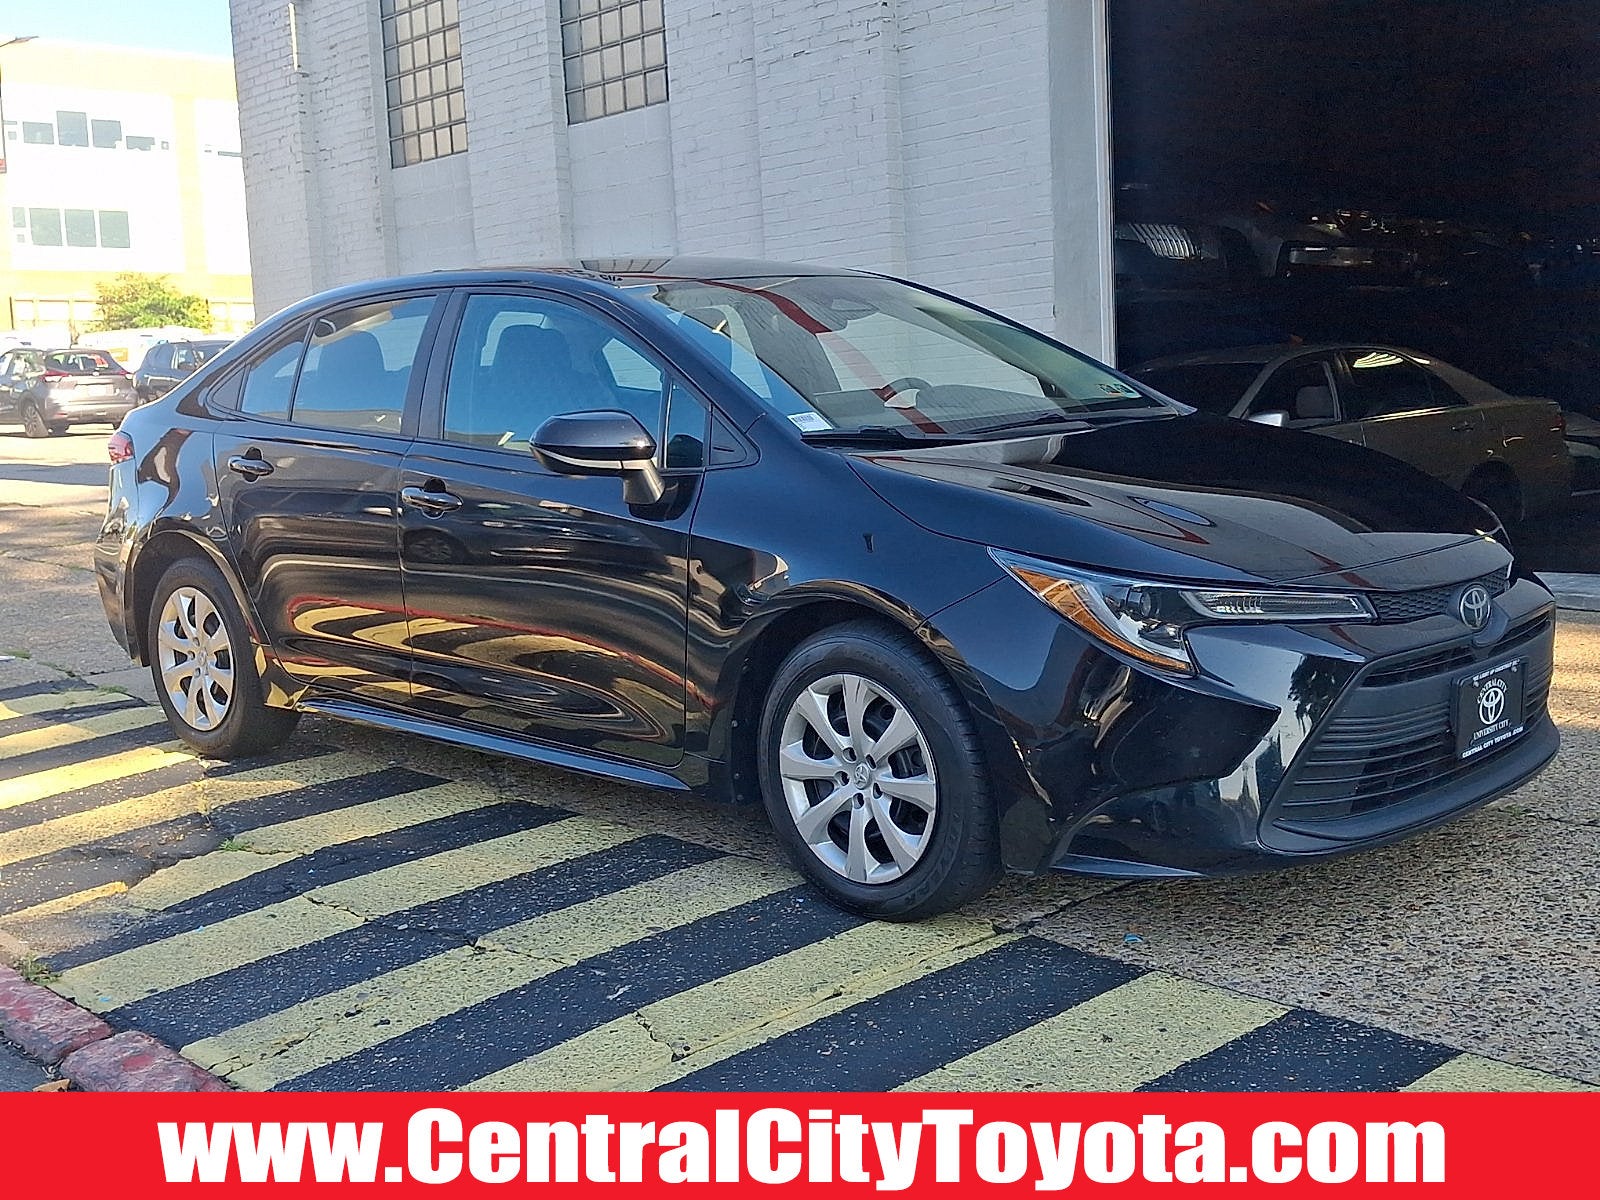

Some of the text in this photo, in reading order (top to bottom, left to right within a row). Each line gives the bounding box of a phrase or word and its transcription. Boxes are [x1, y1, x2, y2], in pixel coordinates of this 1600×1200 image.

[1473, 719, 1510, 741] UNIVERSITY CITY
[1462, 745, 1483, 758] CENTRAL
[1483, 740, 1494, 749] CITY
[1494, 732, 1512, 744] TOYOTA
